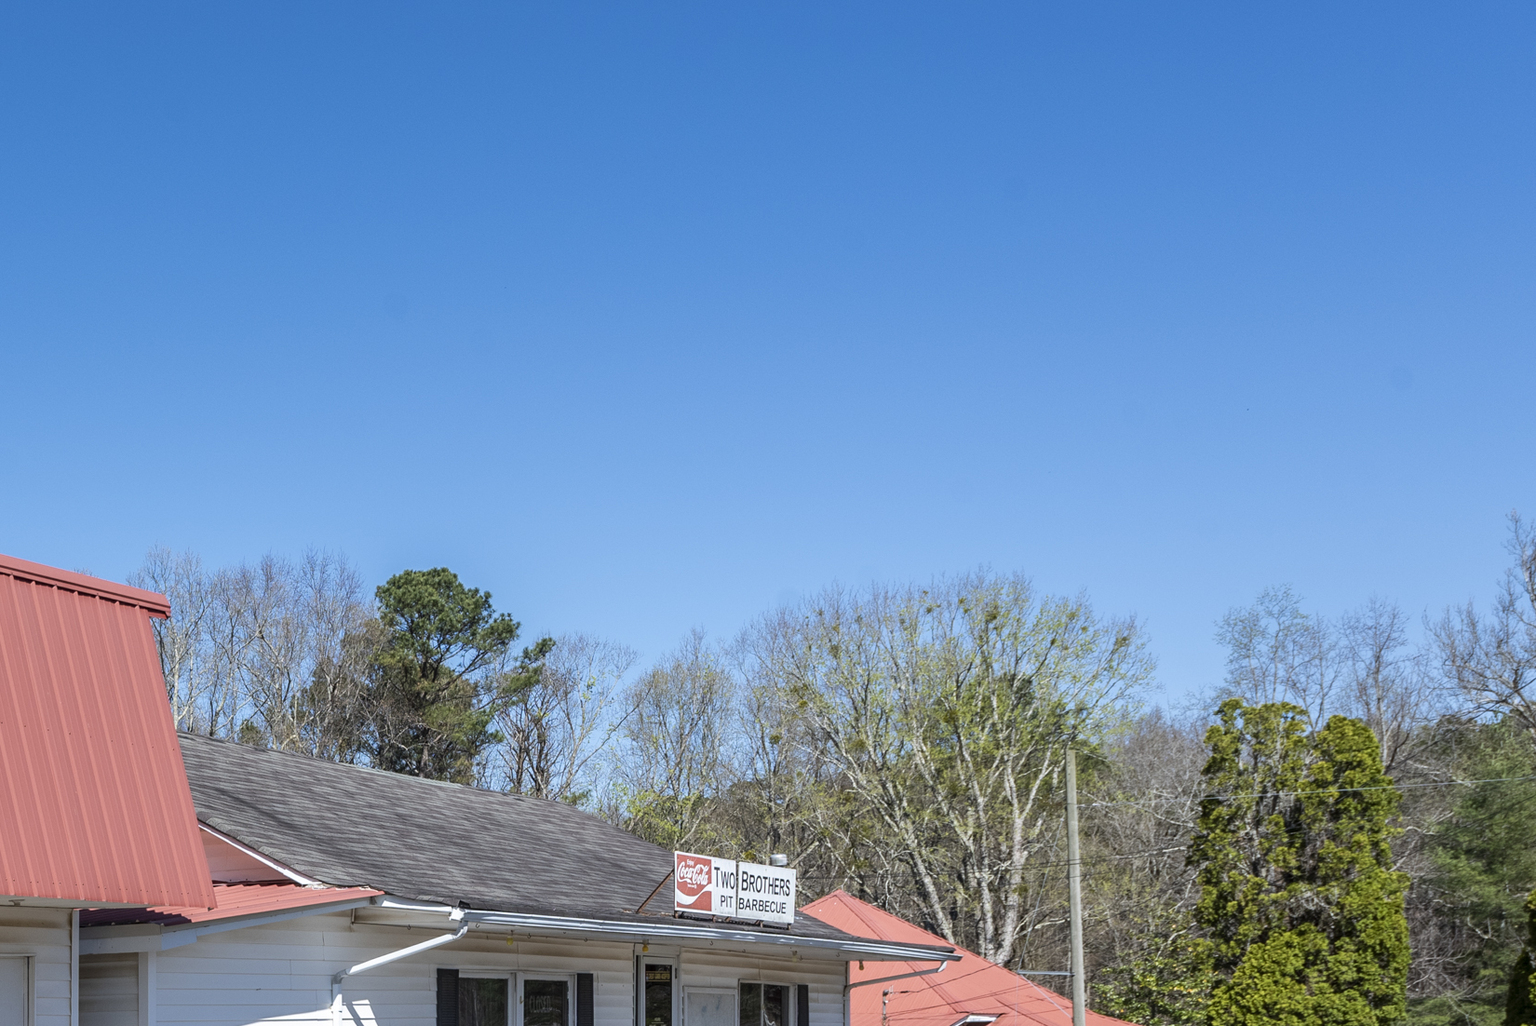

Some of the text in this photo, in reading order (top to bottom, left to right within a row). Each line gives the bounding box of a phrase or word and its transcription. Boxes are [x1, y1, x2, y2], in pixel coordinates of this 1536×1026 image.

[714, 867, 791, 896] TWO BROTHERS
[720, 895, 787, 914] PIT BARBECUE
